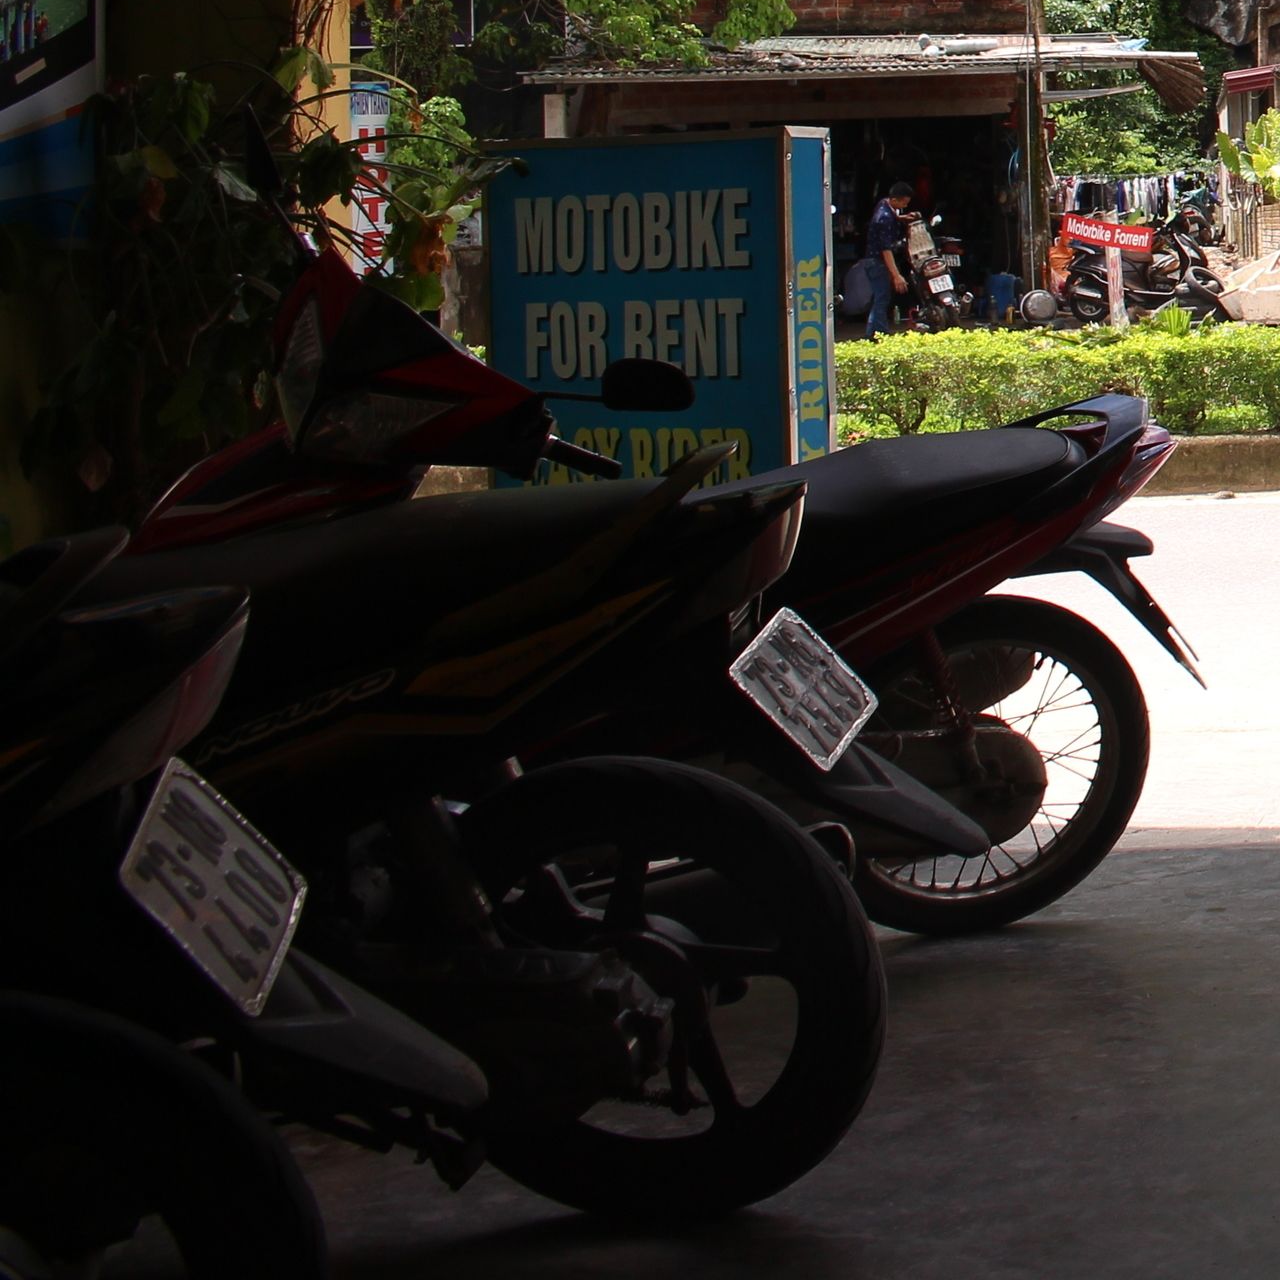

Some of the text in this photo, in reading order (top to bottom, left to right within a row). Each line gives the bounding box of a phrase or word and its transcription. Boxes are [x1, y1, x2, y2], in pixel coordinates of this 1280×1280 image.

[514, 187, 752, 275] MOTOBIKE
[1066, 217, 1150, 247] Motorbike Forrent
[525, 297, 745, 380] FOR RENT
[797, 254, 827, 422] RIDER
